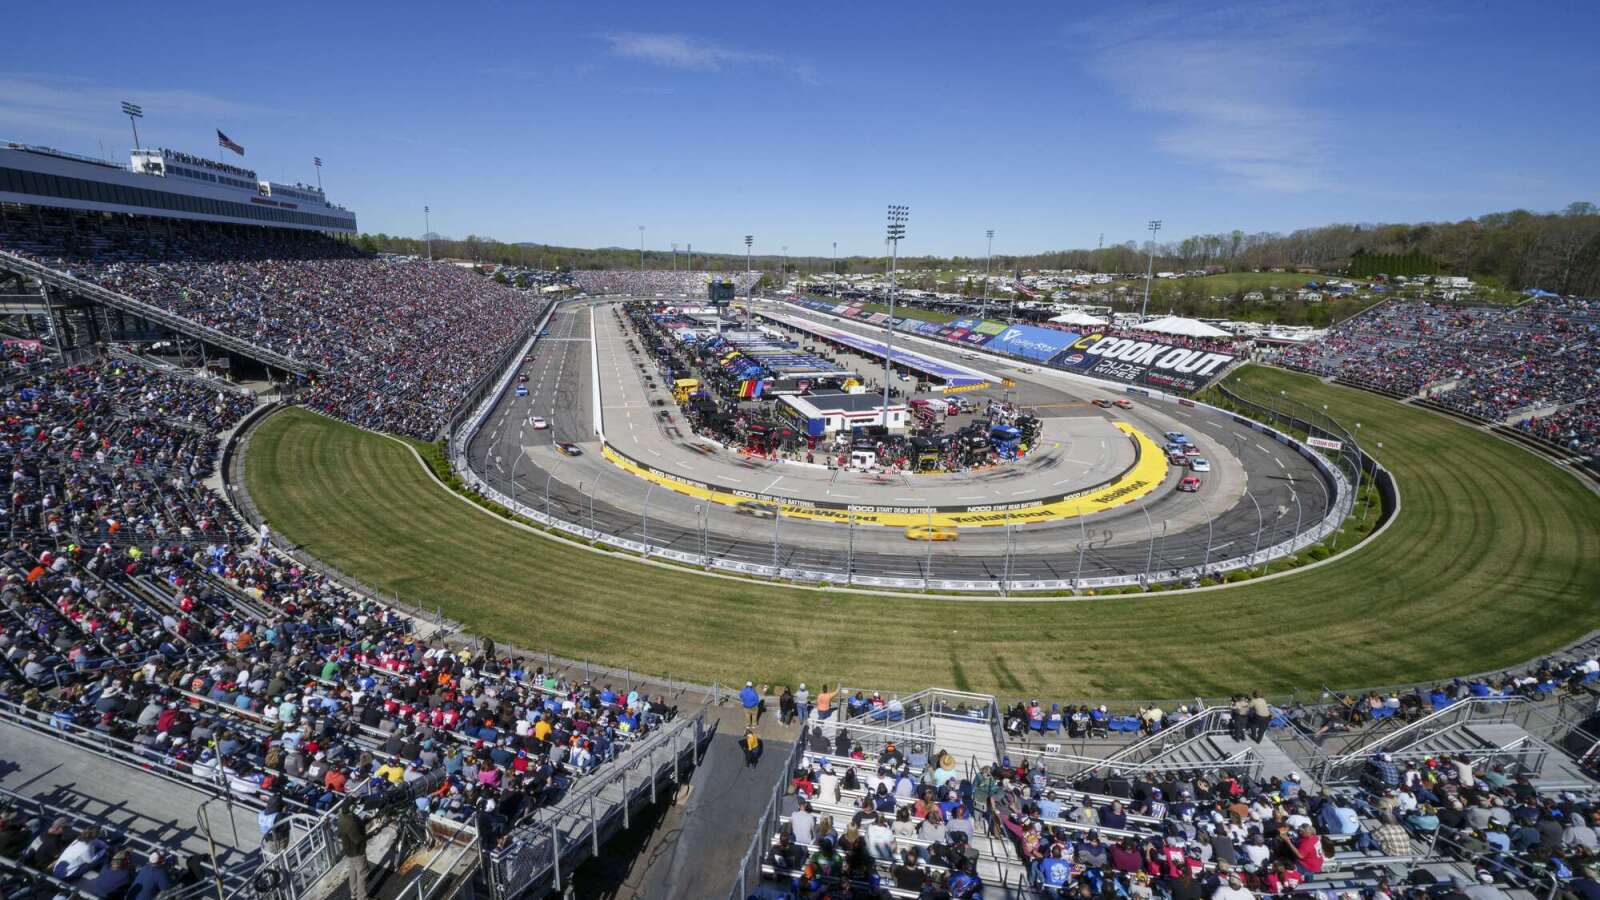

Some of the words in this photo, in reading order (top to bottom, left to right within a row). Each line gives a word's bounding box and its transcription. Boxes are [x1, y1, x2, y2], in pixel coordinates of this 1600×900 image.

[1087, 336, 1173, 365] COOK
[1154, 347, 1235, 377] OUT
[1095, 366, 1136, 380] WIPES
[1100, 360, 1146, 374] DUDE
[732, 489, 756, 499] NOCO
[780, 506, 877, 522] ellaWood
[848, 505, 874, 513] NOCO
[949, 510, 1055, 523] YellaWood
